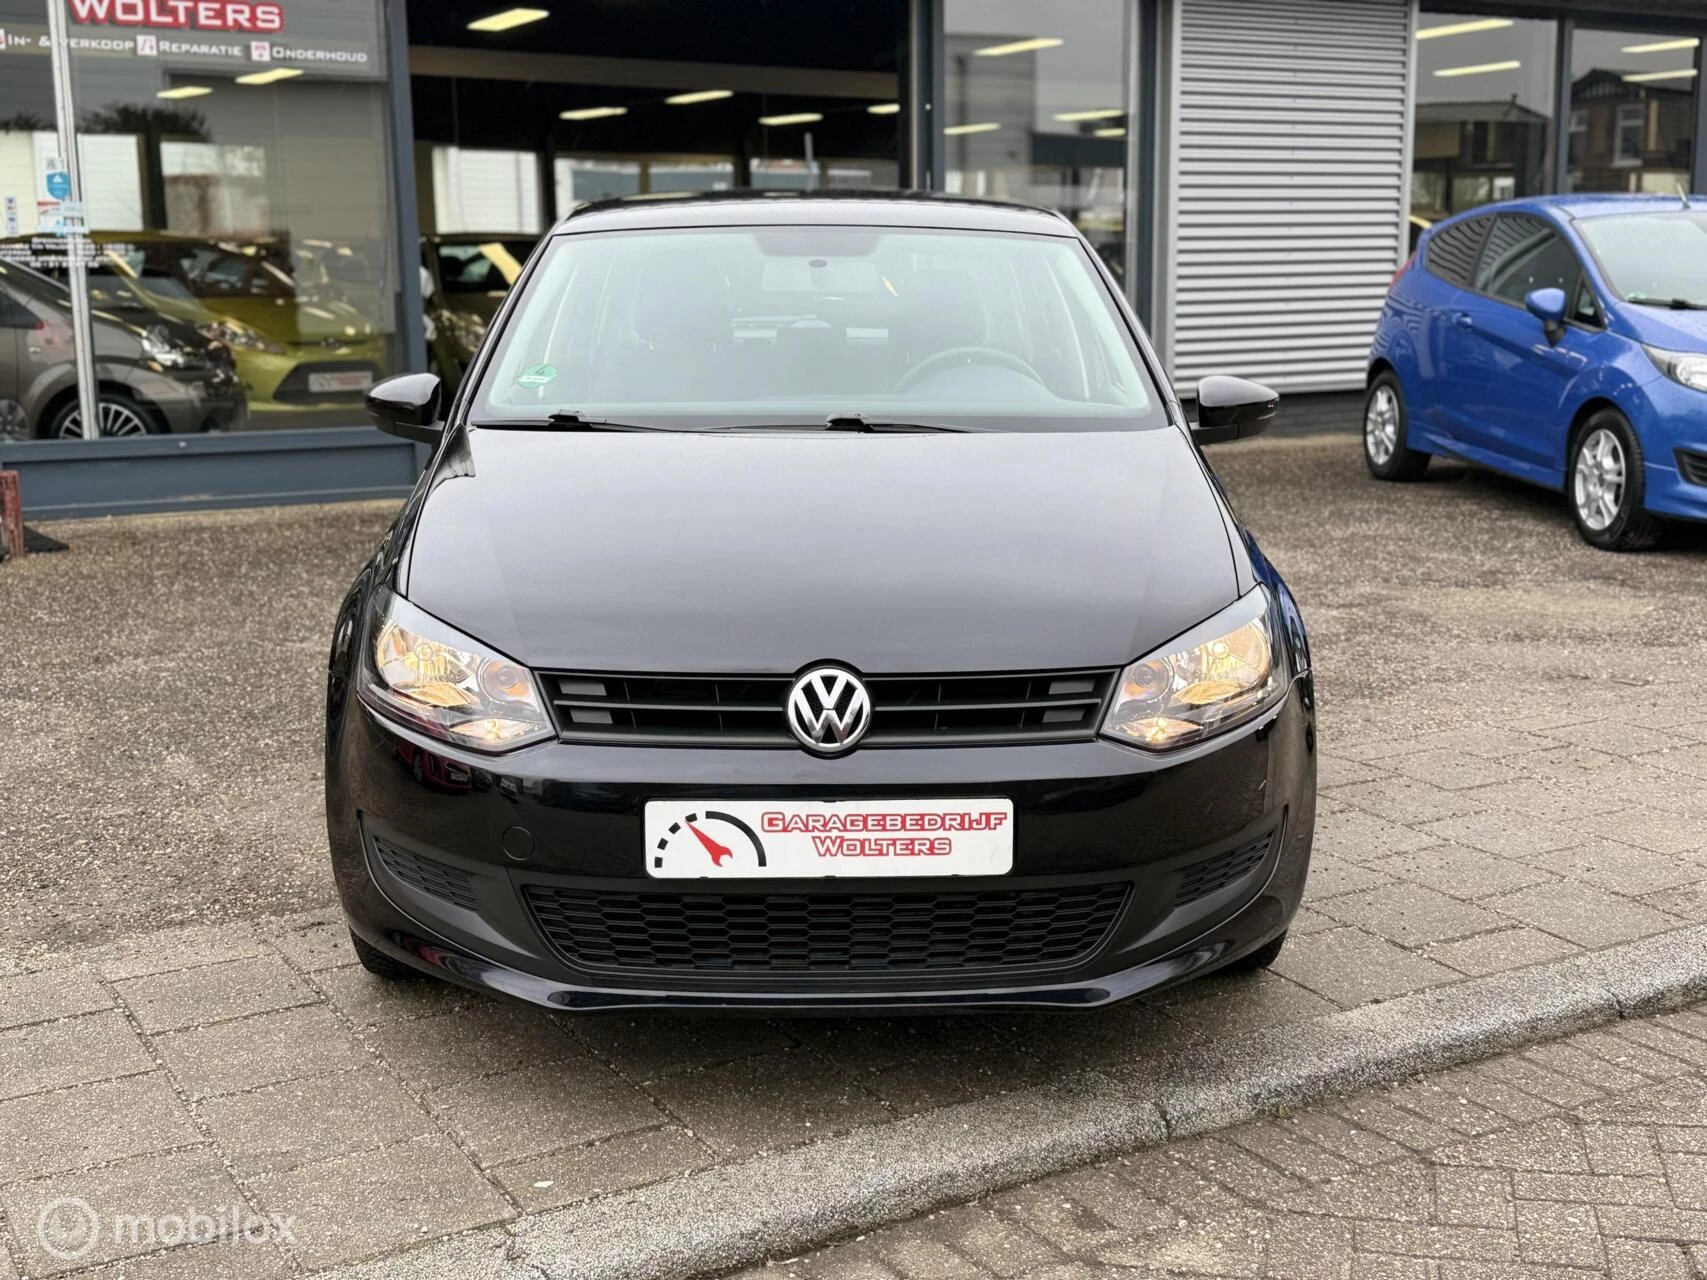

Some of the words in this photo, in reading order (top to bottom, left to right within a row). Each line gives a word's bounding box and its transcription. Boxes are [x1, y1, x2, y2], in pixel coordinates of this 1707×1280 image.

[71, 0, 281, 31] WOLTERS
[38, 35, 51, 47] &
[159, 40, 243, 57] REPARATIE
[271, 46, 368, 62] ONDERHOUD
[791, 669, 867, 746] VW
[761, 812, 1007, 832] GARAGEBEDRIJF
[812, 836, 952, 857] WOLTERS
